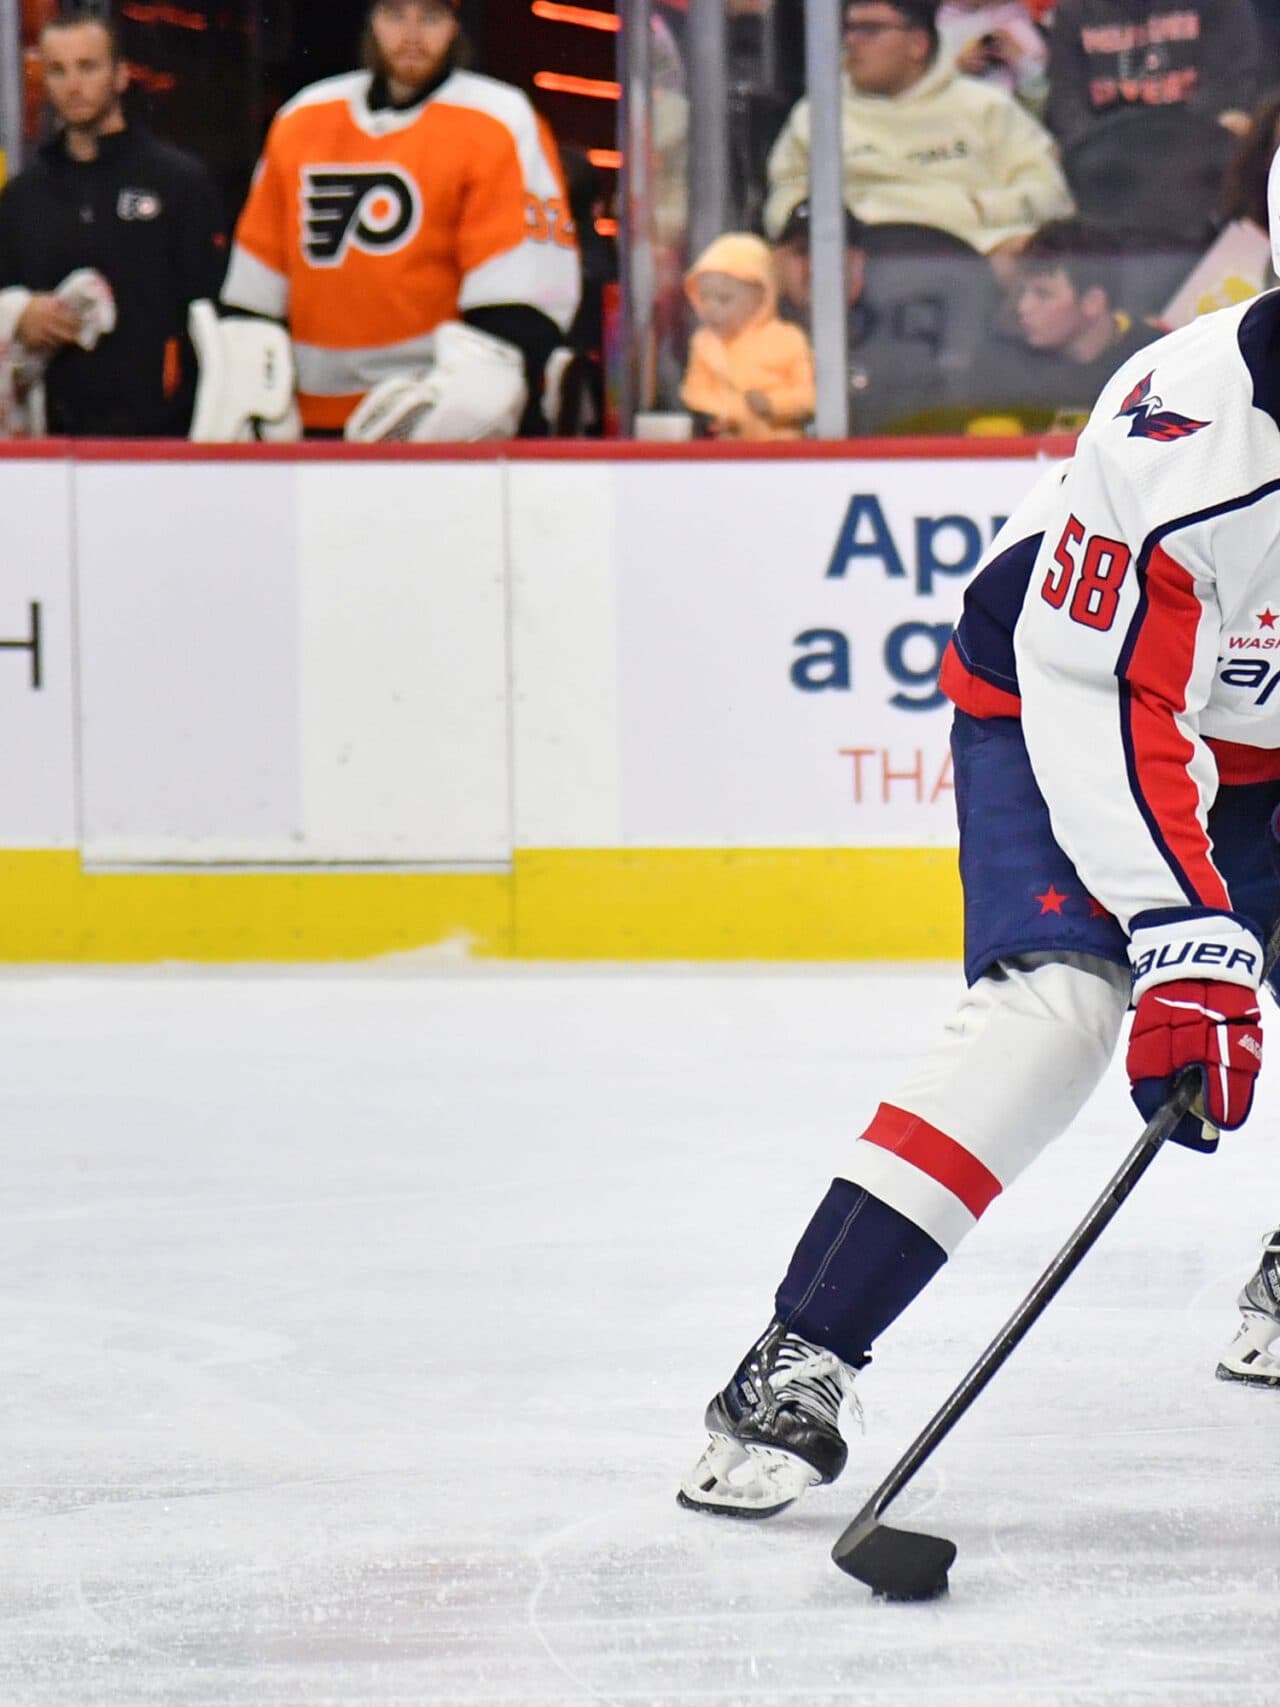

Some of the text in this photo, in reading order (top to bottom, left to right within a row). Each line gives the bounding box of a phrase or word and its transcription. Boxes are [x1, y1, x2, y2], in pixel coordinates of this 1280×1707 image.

[824, 494, 1005, 597] Ap
[1041, 512, 1132, 632] 58
[789, 628, 850, 693] a
[1131, 941, 1257, 981] AUER
